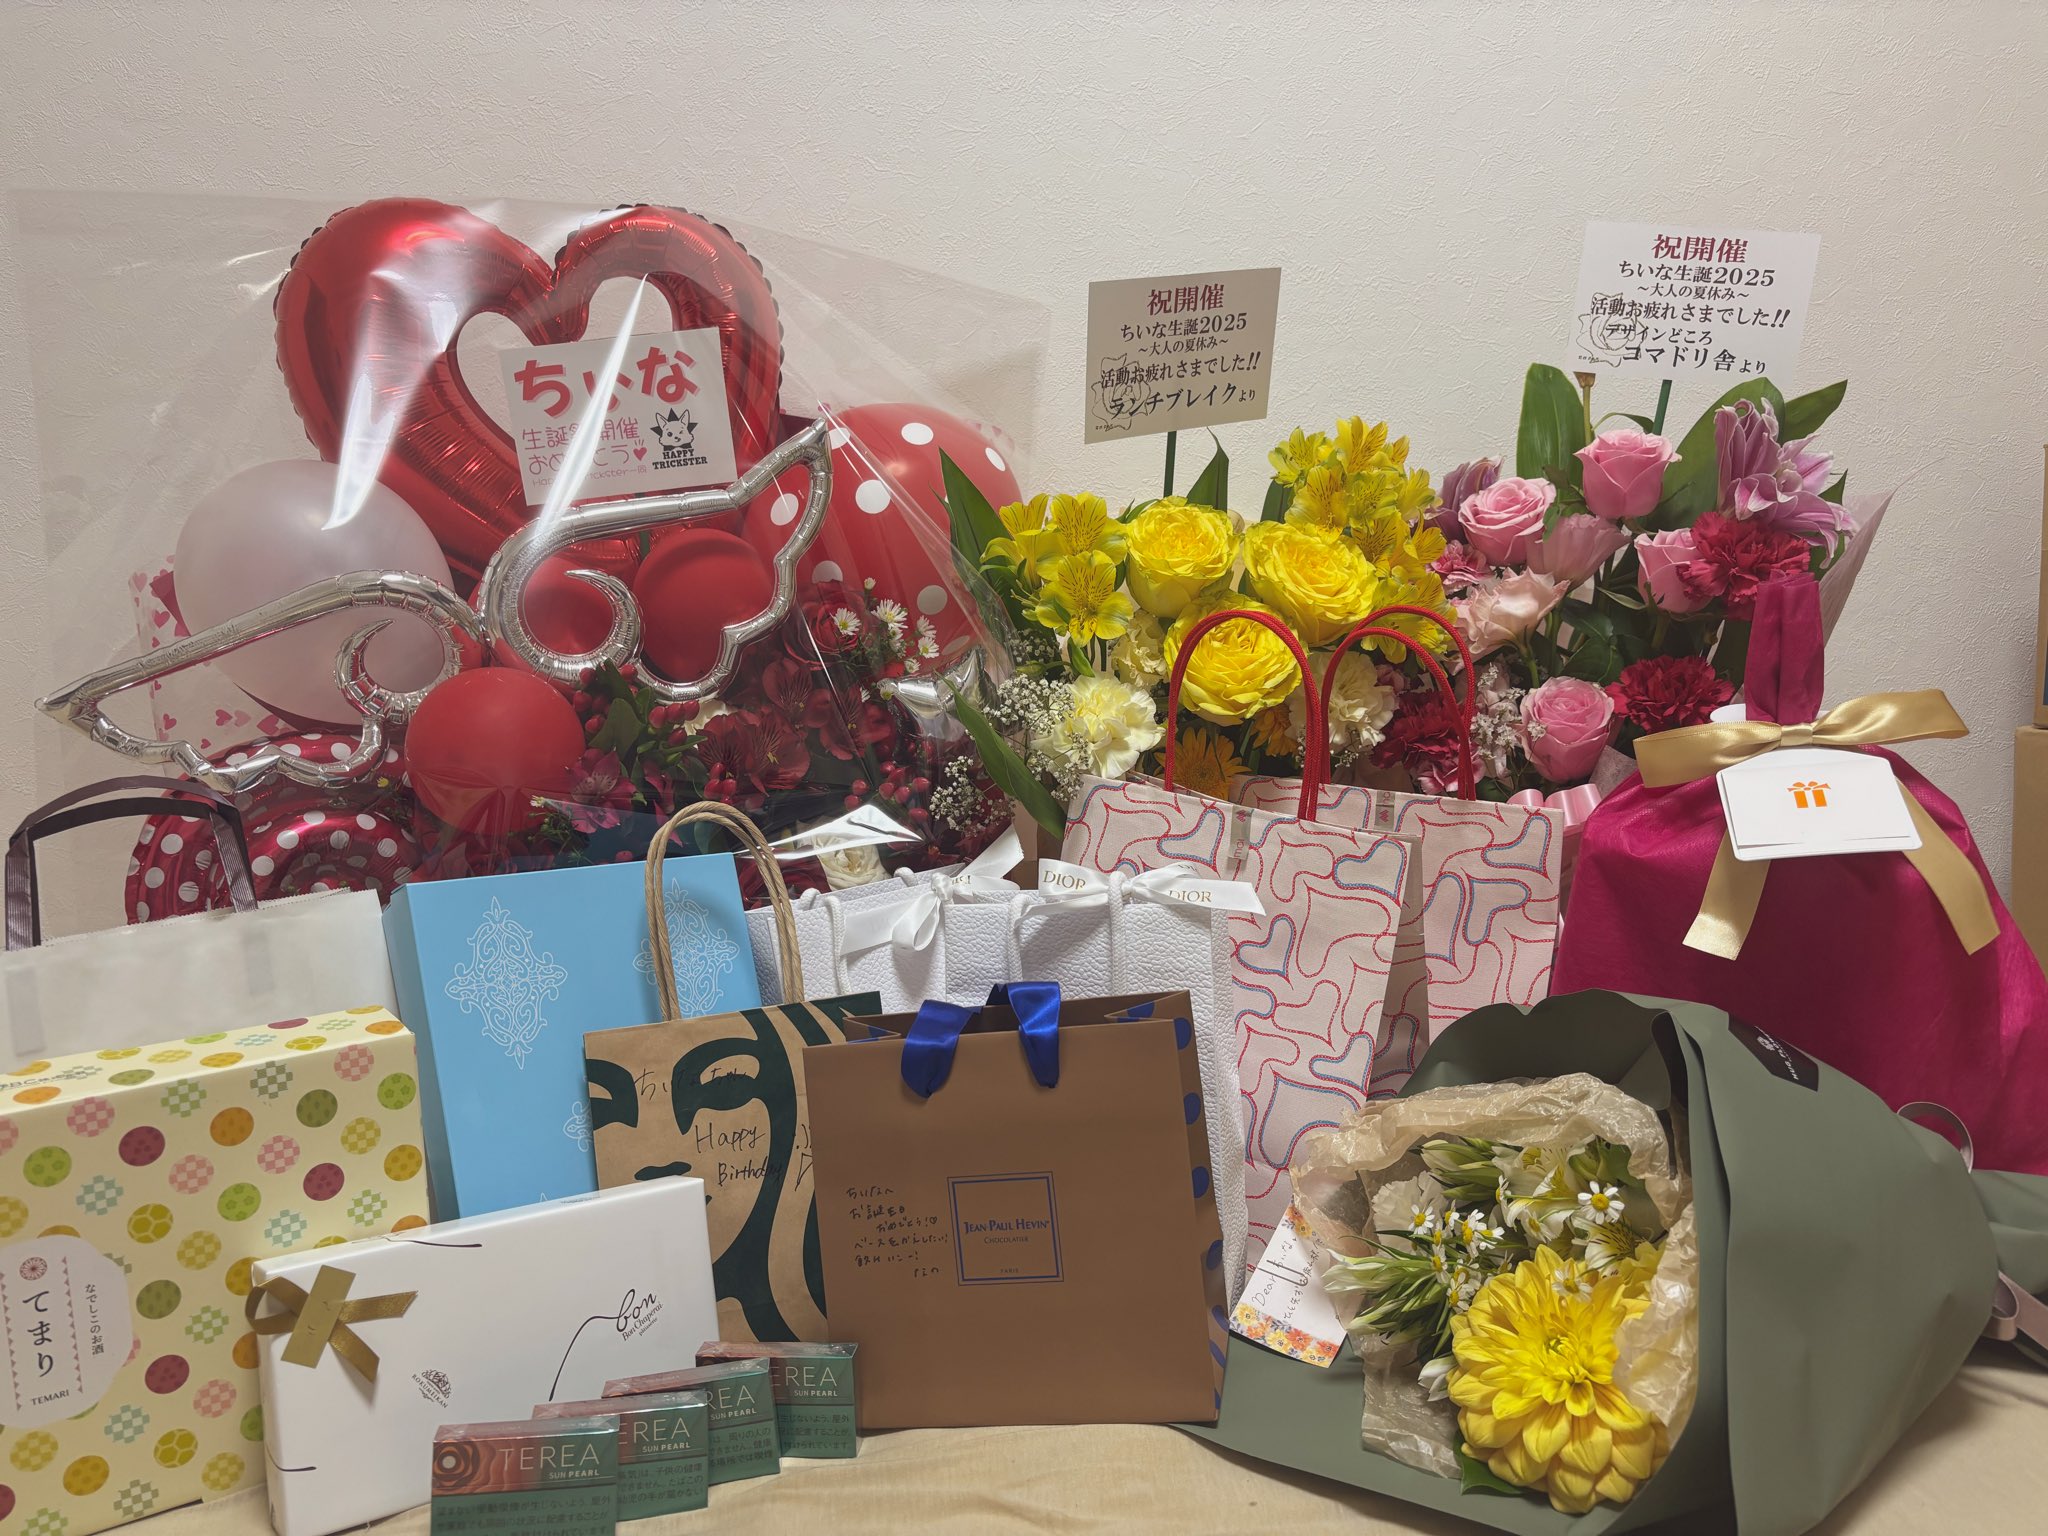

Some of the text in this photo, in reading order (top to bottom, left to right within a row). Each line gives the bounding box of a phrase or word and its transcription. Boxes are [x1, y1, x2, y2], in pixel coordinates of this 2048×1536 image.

[1651, 233, 1749, 263] 祝開催
[1618, 260, 1776, 287] ちいな生誕2025
[1147, 284, 1225, 315] 祝開催
[1120, 312, 1248, 342] ちいな生誕2025
[1605, 322, 1713, 345] デザインどころ
[513, 346, 700, 418] ちいな
[1109, 382, 1257, 420] ランチブレイクより
[522, 416, 640, 450] 生誕開催
[652, 456, 709, 470] TRICKSTER
[662, 448, 695, 460] HAPPY
[1042, 869, 1087, 892] DIOR
[1168, 889, 1213, 904] DIOR
[694, 1122, 766, 1154] Happy
[1251, 1275, 1278, 1307] Dear
[85, 1284, 104, 1356] なでしこのお酒
[616, 1288, 658, 1332] bon
[22, 1290, 54, 1378] てまり
[621, 1326, 637, 1342] Bon
[31, 1388, 70, 1406] TEMARI
[794, 1389, 838, 1397] SUN PEARL
[710, 1407, 758, 1421] SUN PEARL
[498, 1442, 601, 1473] TEREA
[642, 1441, 692, 1454] SUN PEARL
[549, 1468, 601, 1480] SUN PEARL
